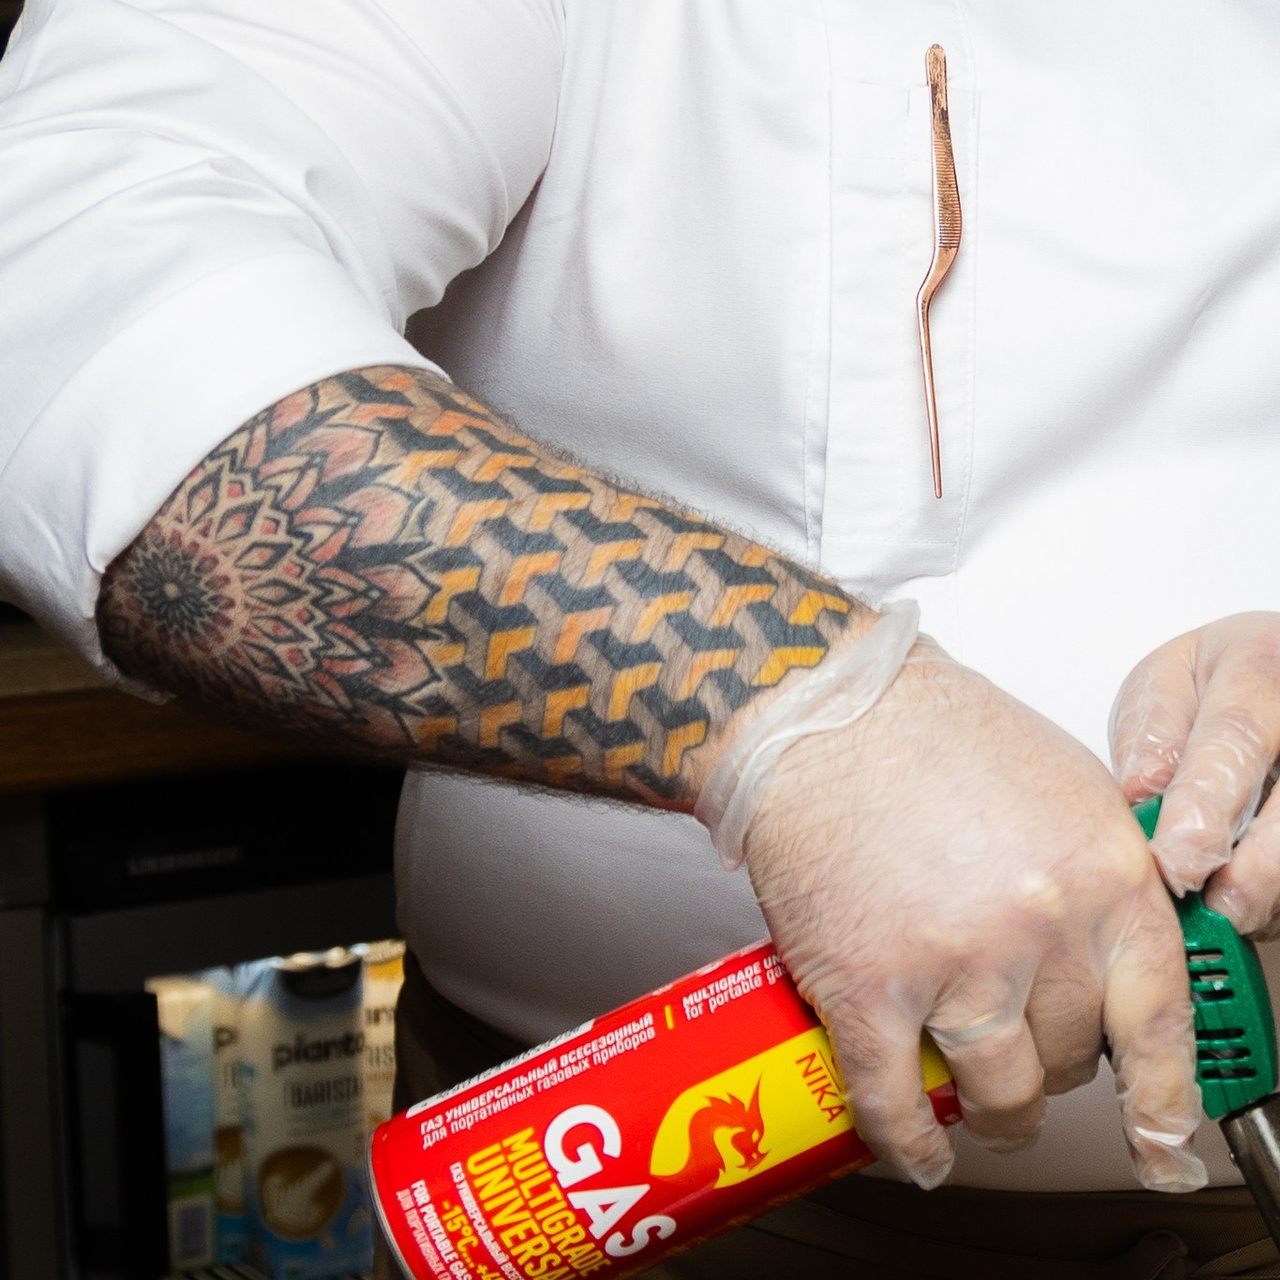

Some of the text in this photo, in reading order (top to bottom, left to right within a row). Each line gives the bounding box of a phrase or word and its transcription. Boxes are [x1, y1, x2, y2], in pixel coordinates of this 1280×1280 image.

[682, 961, 762, 1010] MULTIGRADE
[684, 1000, 704, 1021] for
[705, 972, 763, 1014] portable
[420, 1114, 444, 1136] ГАЗ
[440, 1057, 558, 1123] УНИВЕРСАЛЬНЫЙ
[559, 1012, 654, 1068] ВСЕСЕЗОННЫЙ
[422, 1125, 448, 1150] для
[450, 1084, 535, 1134] портативных
[536, 1056, 591, 1093] газовых
[592, 1026, 656, 1066] приборов
[796, 1051, 846, 1123] NIKA
[395, 1188, 415, 1211] ДЛЯ
[410, 1179, 431, 1207] FOR
[449, 1161, 467, 1186] ГАЗ
[502, 1126, 612, 1277] MULTIGRADE
[545, 1104, 677, 1259] GAS
[419, 1203, 459, 1264] PORTABLE
[455, 1179, 510, 1266] УНИВЕРСАЛЬНЫЙ
